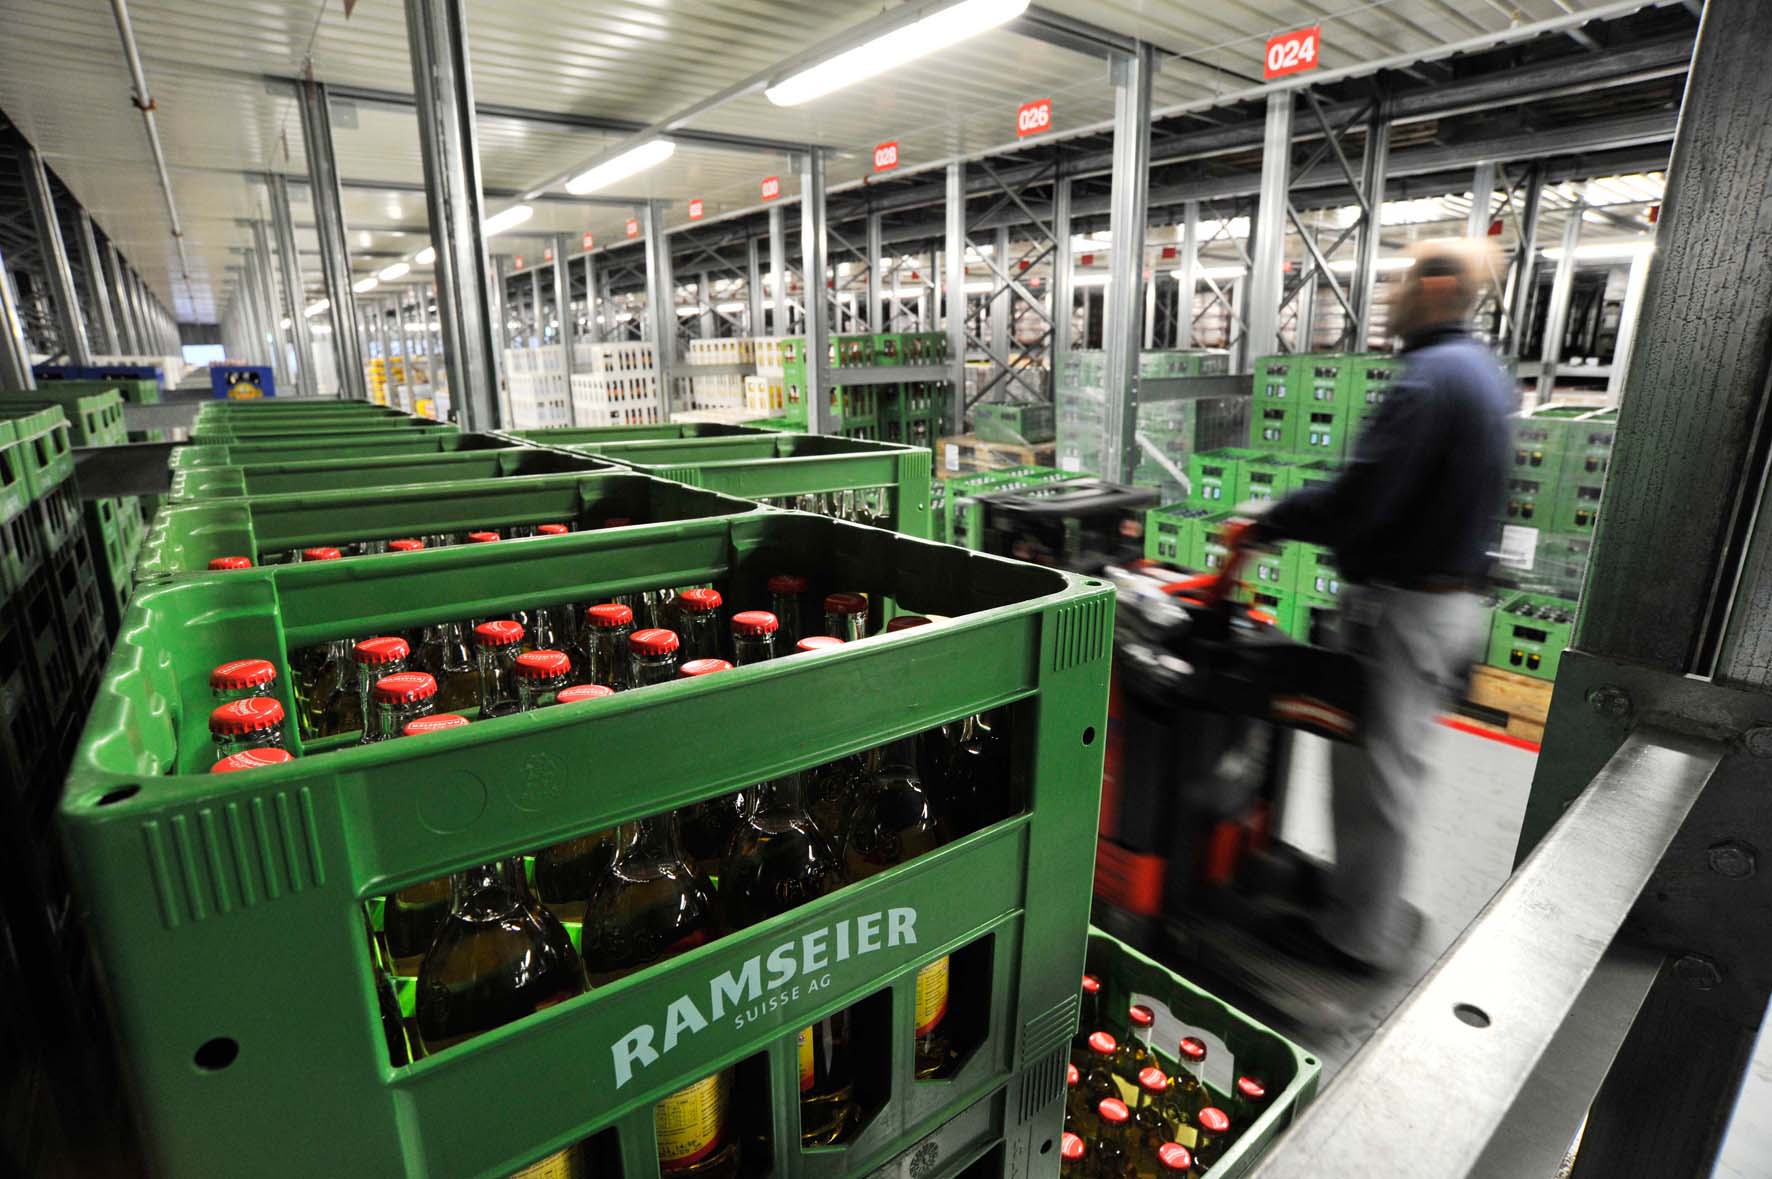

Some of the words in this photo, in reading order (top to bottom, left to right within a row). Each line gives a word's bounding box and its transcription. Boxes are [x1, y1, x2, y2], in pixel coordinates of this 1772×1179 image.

[1268, 35, 1316, 71] 024
[1018, 104, 1049, 131] 026
[610, 907, 917, 1090] RAMSEIER
[734, 986, 800, 1030] SUISSE
[807, 973, 831, 994] AG
